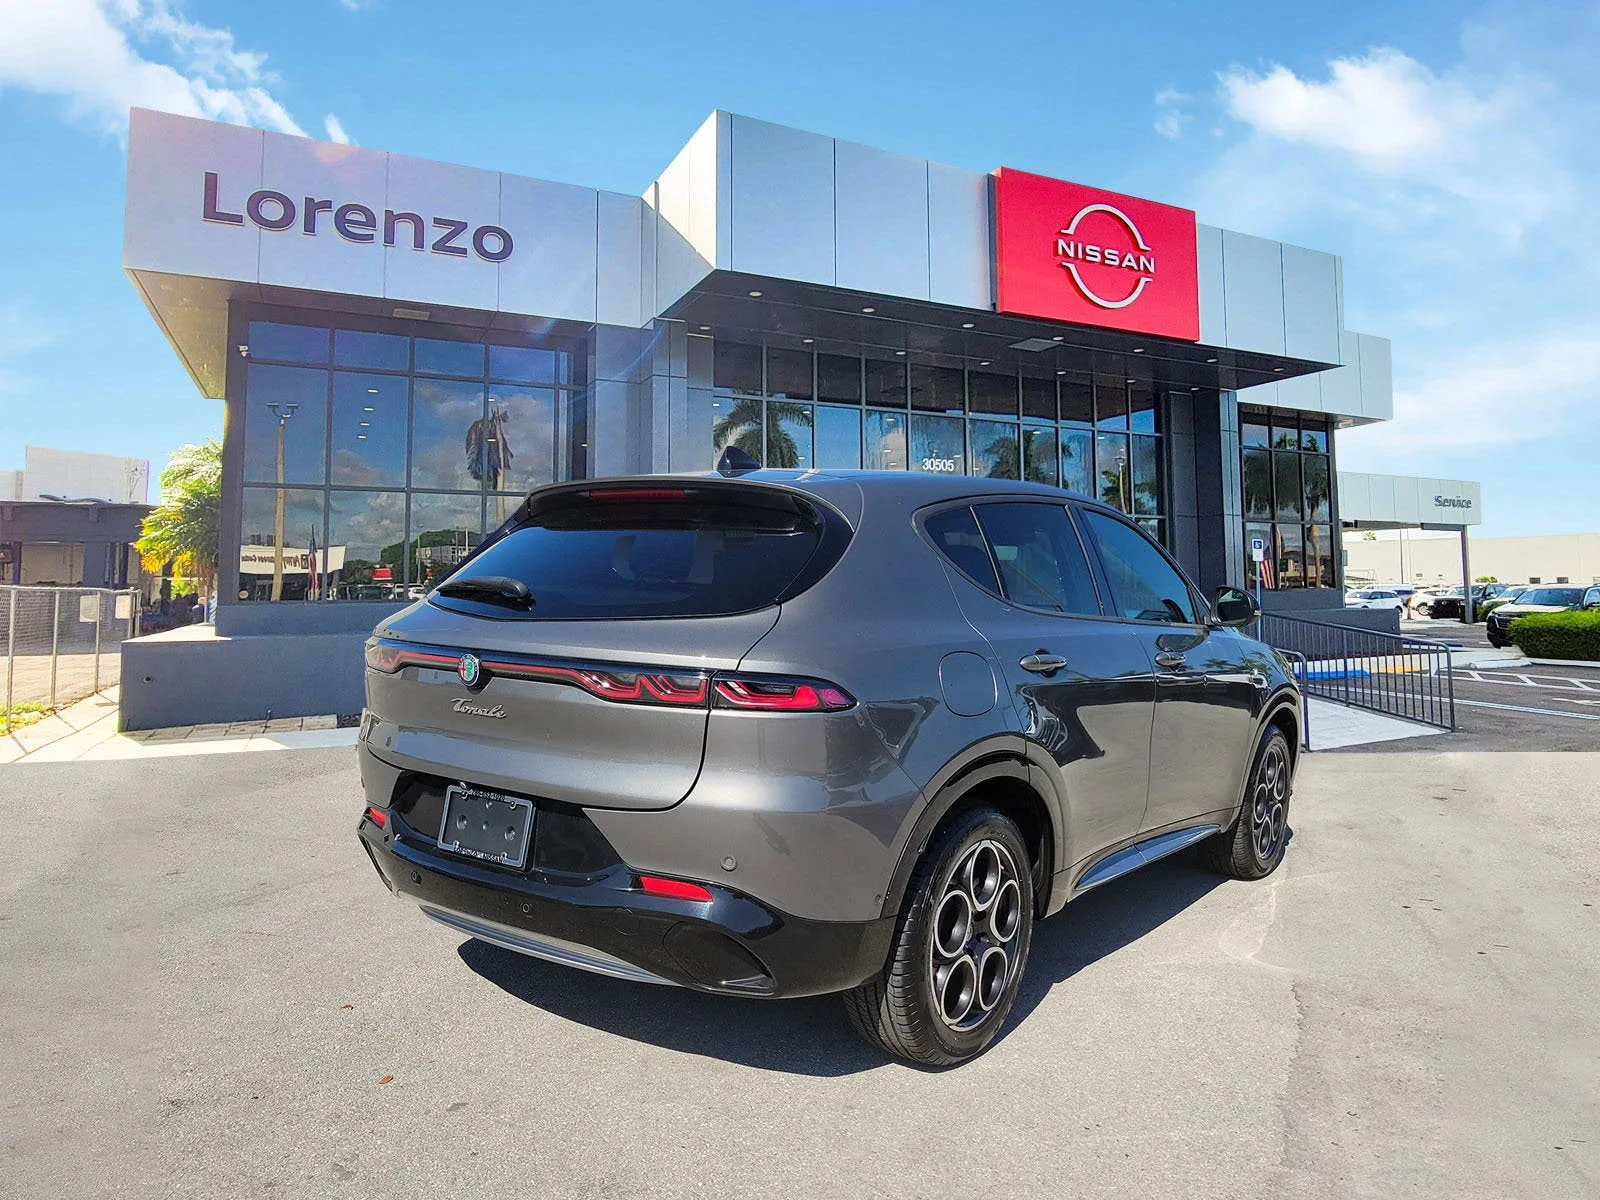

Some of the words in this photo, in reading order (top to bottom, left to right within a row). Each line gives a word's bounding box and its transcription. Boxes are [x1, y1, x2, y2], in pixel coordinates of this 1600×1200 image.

[203, 171, 515, 262] Lorenzo
[1057, 238, 1155, 273] NISSAN
[922, 457, 955, 472] 30505
[1434, 495, 1472, 508] Service
[450, 697, 507, 718] Tonale
